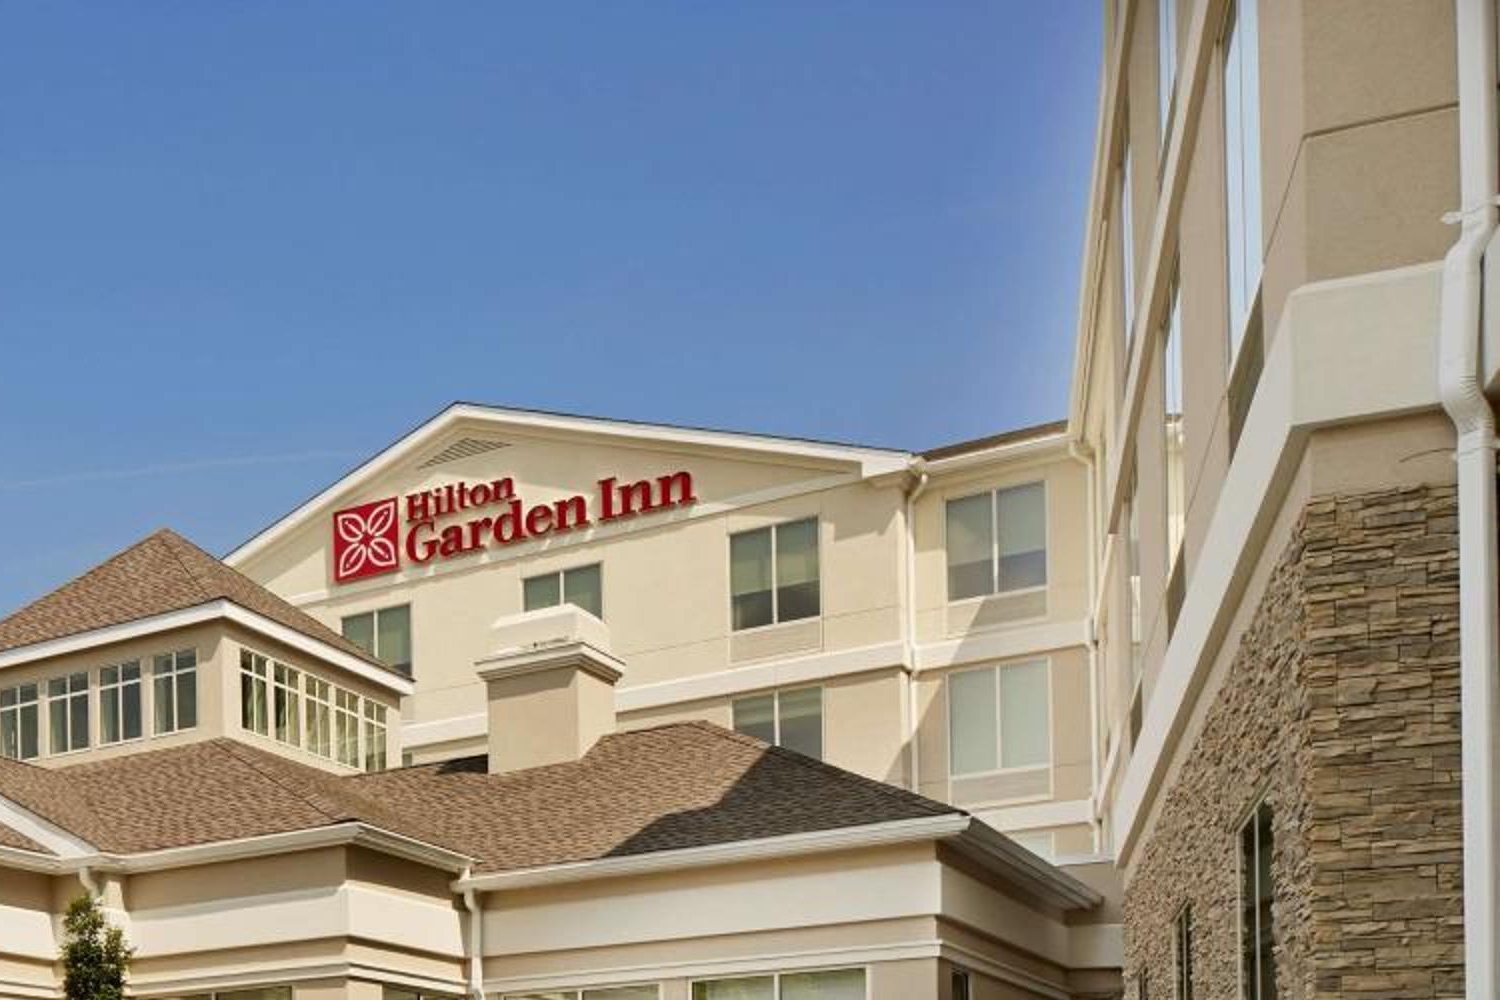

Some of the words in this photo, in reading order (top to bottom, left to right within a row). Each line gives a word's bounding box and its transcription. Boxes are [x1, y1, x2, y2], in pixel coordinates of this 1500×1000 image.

[406, 476, 515, 523] Hilton
[406, 494, 589, 562] Garden
[598, 470, 696, 521] Inn
